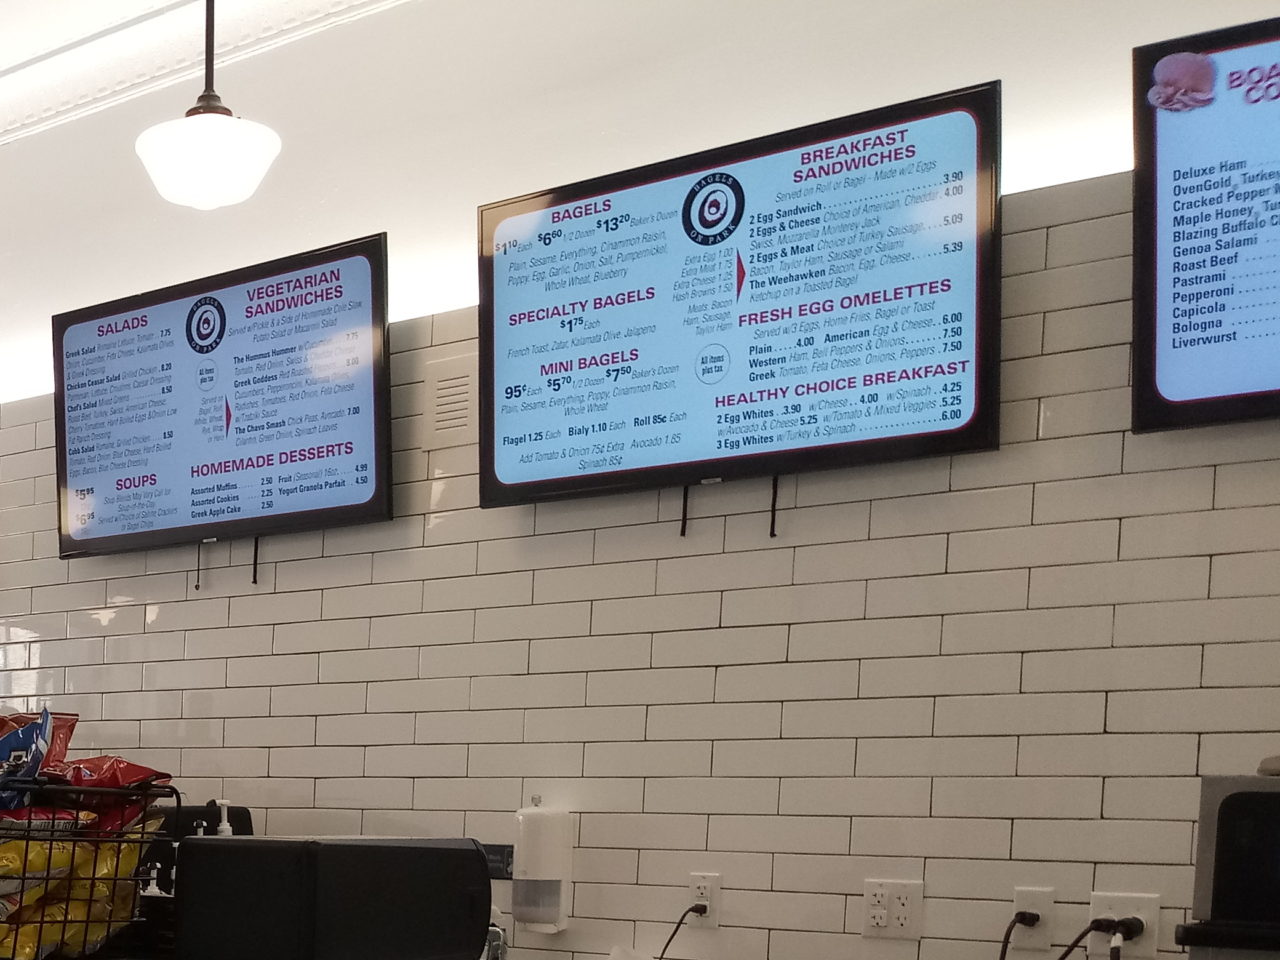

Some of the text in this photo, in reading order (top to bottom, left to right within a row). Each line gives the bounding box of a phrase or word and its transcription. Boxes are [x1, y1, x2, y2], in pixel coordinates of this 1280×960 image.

[801, 128, 908, 165] BREAKFAST
[793, 144, 915, 183] SANDWICHES
[1173, 156, 1246, 182] Deluxe Ham
[551, 198, 611, 223] BAGELS
[749, 170, 963, 225] 2 Egg Sandwich 3.90
[749, 184, 963, 238] 2 Eggs & Cheese 4.00
[1173, 184, 1269, 212] Cracked Pepper
[1173, 202, 1253, 229] Maple Honey
[690, 222, 736, 244] ON PARK
[749, 213, 962, 264] 2 Eggs & Meat 5.09
[1173, 216, 1265, 244] Blazing Buffalo
[1173, 234, 1257, 258] Genoa Salami
[750, 241, 962, 289] The Weehawken 5.39
[1173, 252, 1238, 273] Roast Beef
[246, 268, 340, 302] VEGETARIAN
[1173, 270, 1225, 289] Pastrami
[245, 284, 343, 319] SANDWICHES
[509, 286, 655, 326] SPECIALTY BAGELS
[738, 278, 951, 327] FRESH EGG OMELETTES
[1173, 285, 1234, 306] Pepperoni
[1173, 301, 1225, 321] Capicola
[97, 314, 147, 337] SALADS
[749, 312, 962, 355] Plain 4.00 American 6.00
[1173, 318, 1221, 336] Bologna
[81, 345, 95, 355] Salad
[749, 326, 962, 369] Western 7.50
[1172, 331, 1236, 349] Liverwurst
[233, 355, 243, 364] The
[540, 348, 638, 376] MINI BAGELS
[749, 340, 961, 382] Greek 7.50
[67, 380, 86, 391] Chicken
[106, 373, 120, 383] Salad
[234, 372, 277, 388] Greek Goddess
[715, 360, 969, 408] HEALTHY CHOICE BREAKFAST
[83, 400, 97, 409] Salad
[717, 381, 961, 425] 2 Egg Whites 3.90 4.00 4.25
[800, 394, 961, 425] 5.25 5.25
[235, 425, 245, 434] The
[266, 418, 285, 429] Smash
[503, 434, 525, 446] Flagel
[528, 432, 542, 441] 1.25
[568, 425, 588, 438] Bialy
[591, 422, 606, 432] 1.10
[633, 416, 650, 426] Roll
[717, 408, 961, 450] 3 Egg Whites 6.00
[81, 444, 94, 453] Salad
[190, 441, 353, 478] HOMEMADE DESSERTS
[116, 473, 156, 490] SOUPS
[190, 485, 214, 495] Assorted
[216, 481, 237, 492] Muffins
[261, 476, 272, 485] 2.50
[278, 474, 291, 483] Fruit
[191, 497, 214, 507] Assorted
[216, 493, 239, 503] Cookies
[261, 488, 272, 497] 2.25
[278, 485, 297, 497] Yogurt
[299, 482, 322, 492] Granola
[324, 478, 345, 489] Parfait
[191, 500, 273, 518] Greek Apple Cake 2.50
